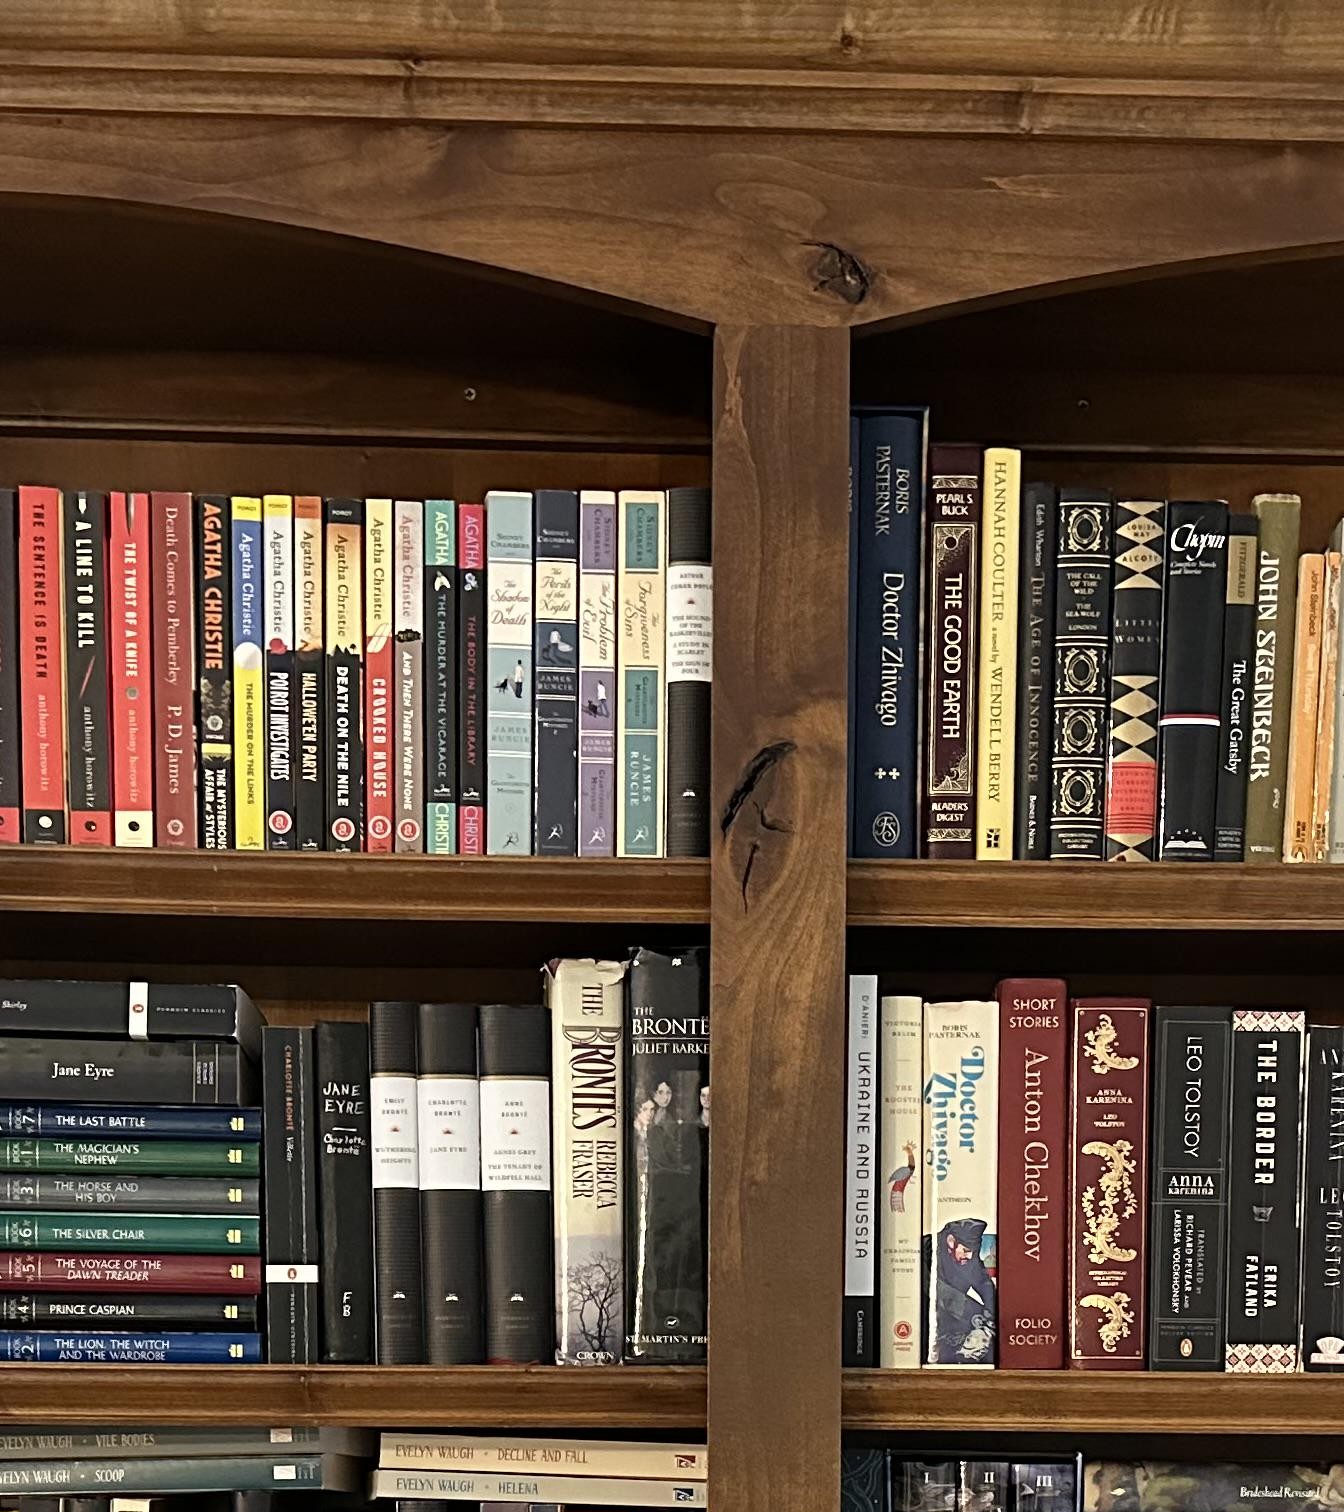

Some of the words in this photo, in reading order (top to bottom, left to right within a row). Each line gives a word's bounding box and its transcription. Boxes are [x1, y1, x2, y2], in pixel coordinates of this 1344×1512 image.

[1258, 551, 1279, 620] JOHN
[881, 572, 905, 640] Doctor
[337, 666, 349, 712] DEATH
[875, 646, 904, 726] Zhivago
[1250, 629, 1276, 782] STEINBECK
[337, 717, 349, 737] ON
[337, 742, 349, 769] THE
[337, 774, 349, 806] NILE
[1009, 1015, 1059, 1029] STORIES
[1013, 999, 1055, 1011] SHORT
[52, 1063, 80, 1078] Jane
[84, 1063, 114, 1079] Eyre
[1257, 1040, 1277, 1084] THE
[323, 1082, 360, 1097] JANE
[325, 1100, 365, 1115] EYRE
[857, 1053, 872, 1132] UKRAINE
[1023, 1048, 1046, 1134] Anton
[56, 1115, 76, 1126] THE
[80, 1115, 104, 1127] LAST
[108, 1116, 145, 1127] BATTLE
[1255, 1097, 1276, 1184] BORDER
[572, 1141, 593, 1199] FRASER
[596, 1141, 617, 1209] REBECCA
[856, 1144, 870, 1179] AND
[1023, 1143, 1049, 1262] Chekhov
[855, 1189, 869, 1259] RUSSIA
[1009, 1332, 1057, 1346] SOCIETY
[1015, 1318, 1051, 1330] FOLIO
[396, 1445, 434, 1459] EVELYN
[437, 1446, 474, 1460] WAUGH
[498, 1448, 537, 1462] DECLINE
[542, 1449, 561, 1462] AND
[565, 1449, 588, 1463] FALL
